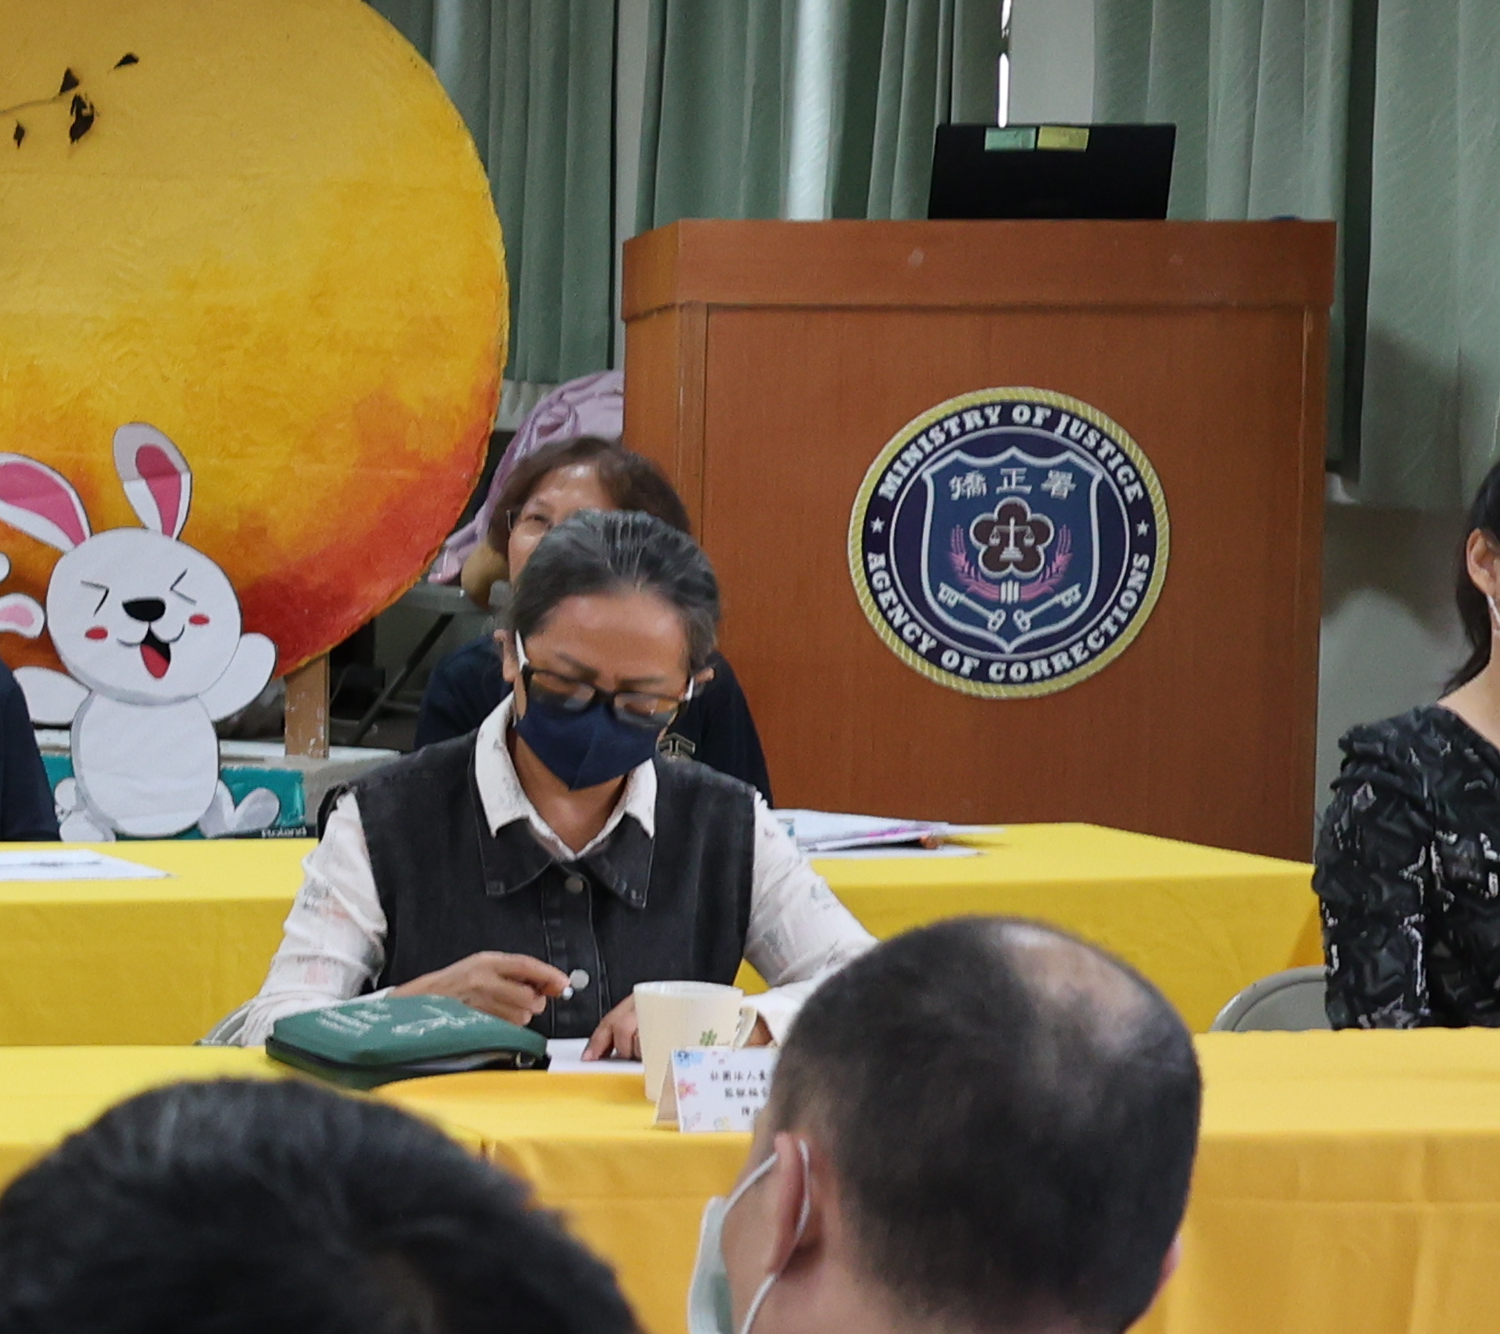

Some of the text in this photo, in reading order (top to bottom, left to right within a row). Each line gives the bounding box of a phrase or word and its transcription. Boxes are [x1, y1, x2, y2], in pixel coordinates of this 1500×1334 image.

[878, 403, 1145, 503] MINISTRY OF JUSTICE
[948, 467, 1077, 501] 矯正署
[866, 552, 1151, 682] AGENCY OF CORRECTIONS
